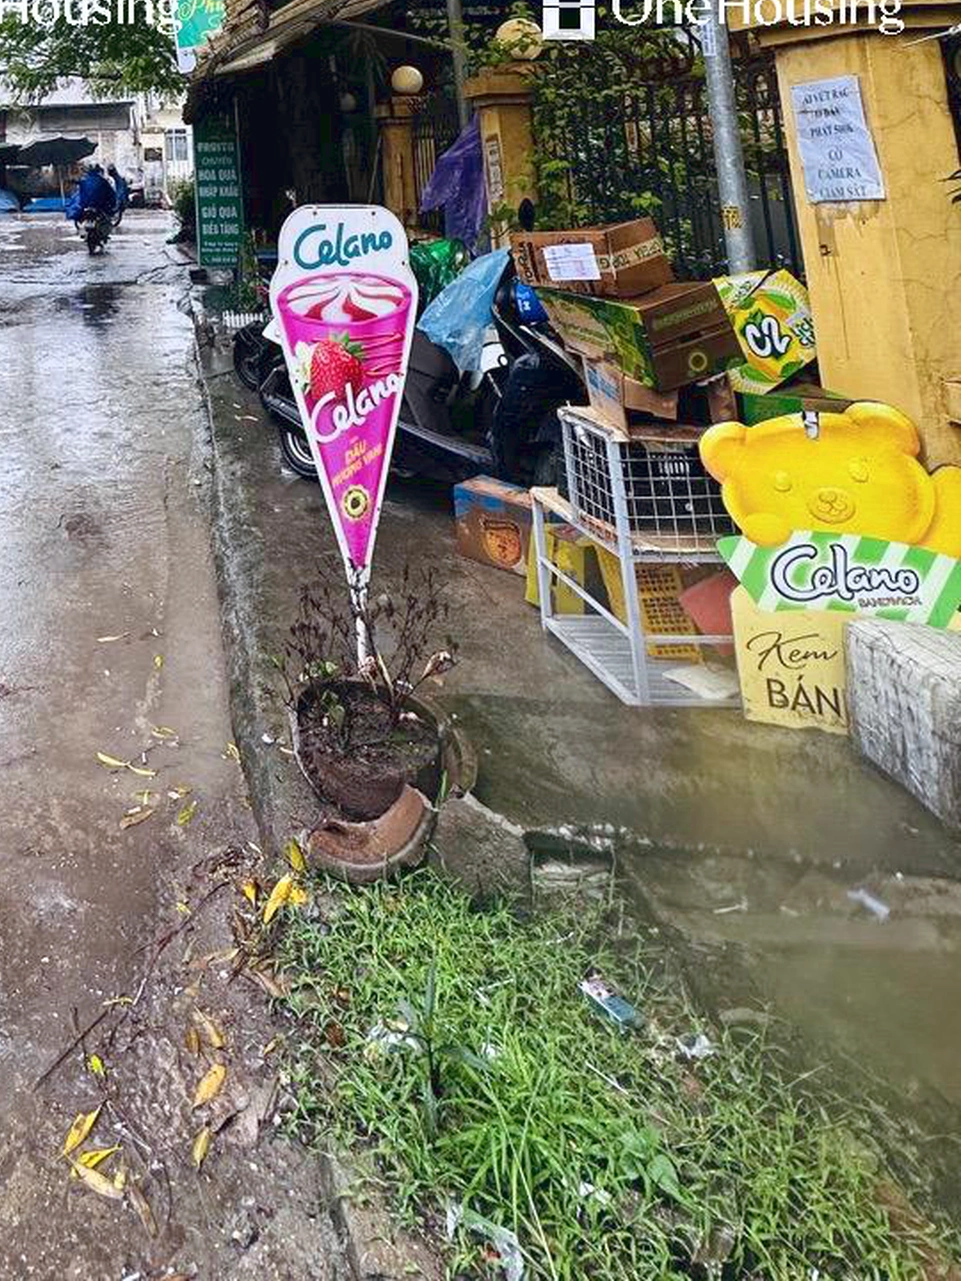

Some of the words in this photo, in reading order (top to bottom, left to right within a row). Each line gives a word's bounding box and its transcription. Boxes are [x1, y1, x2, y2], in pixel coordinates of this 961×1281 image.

[293, 223, 393, 269] Celano
[744, 314, 793, 359] C2
[311, 373, 404, 445] Celano
[771, 543, 919, 602] Celano
[746, 631, 839, 671] Kem
[766, 675, 842, 717] BÁN
